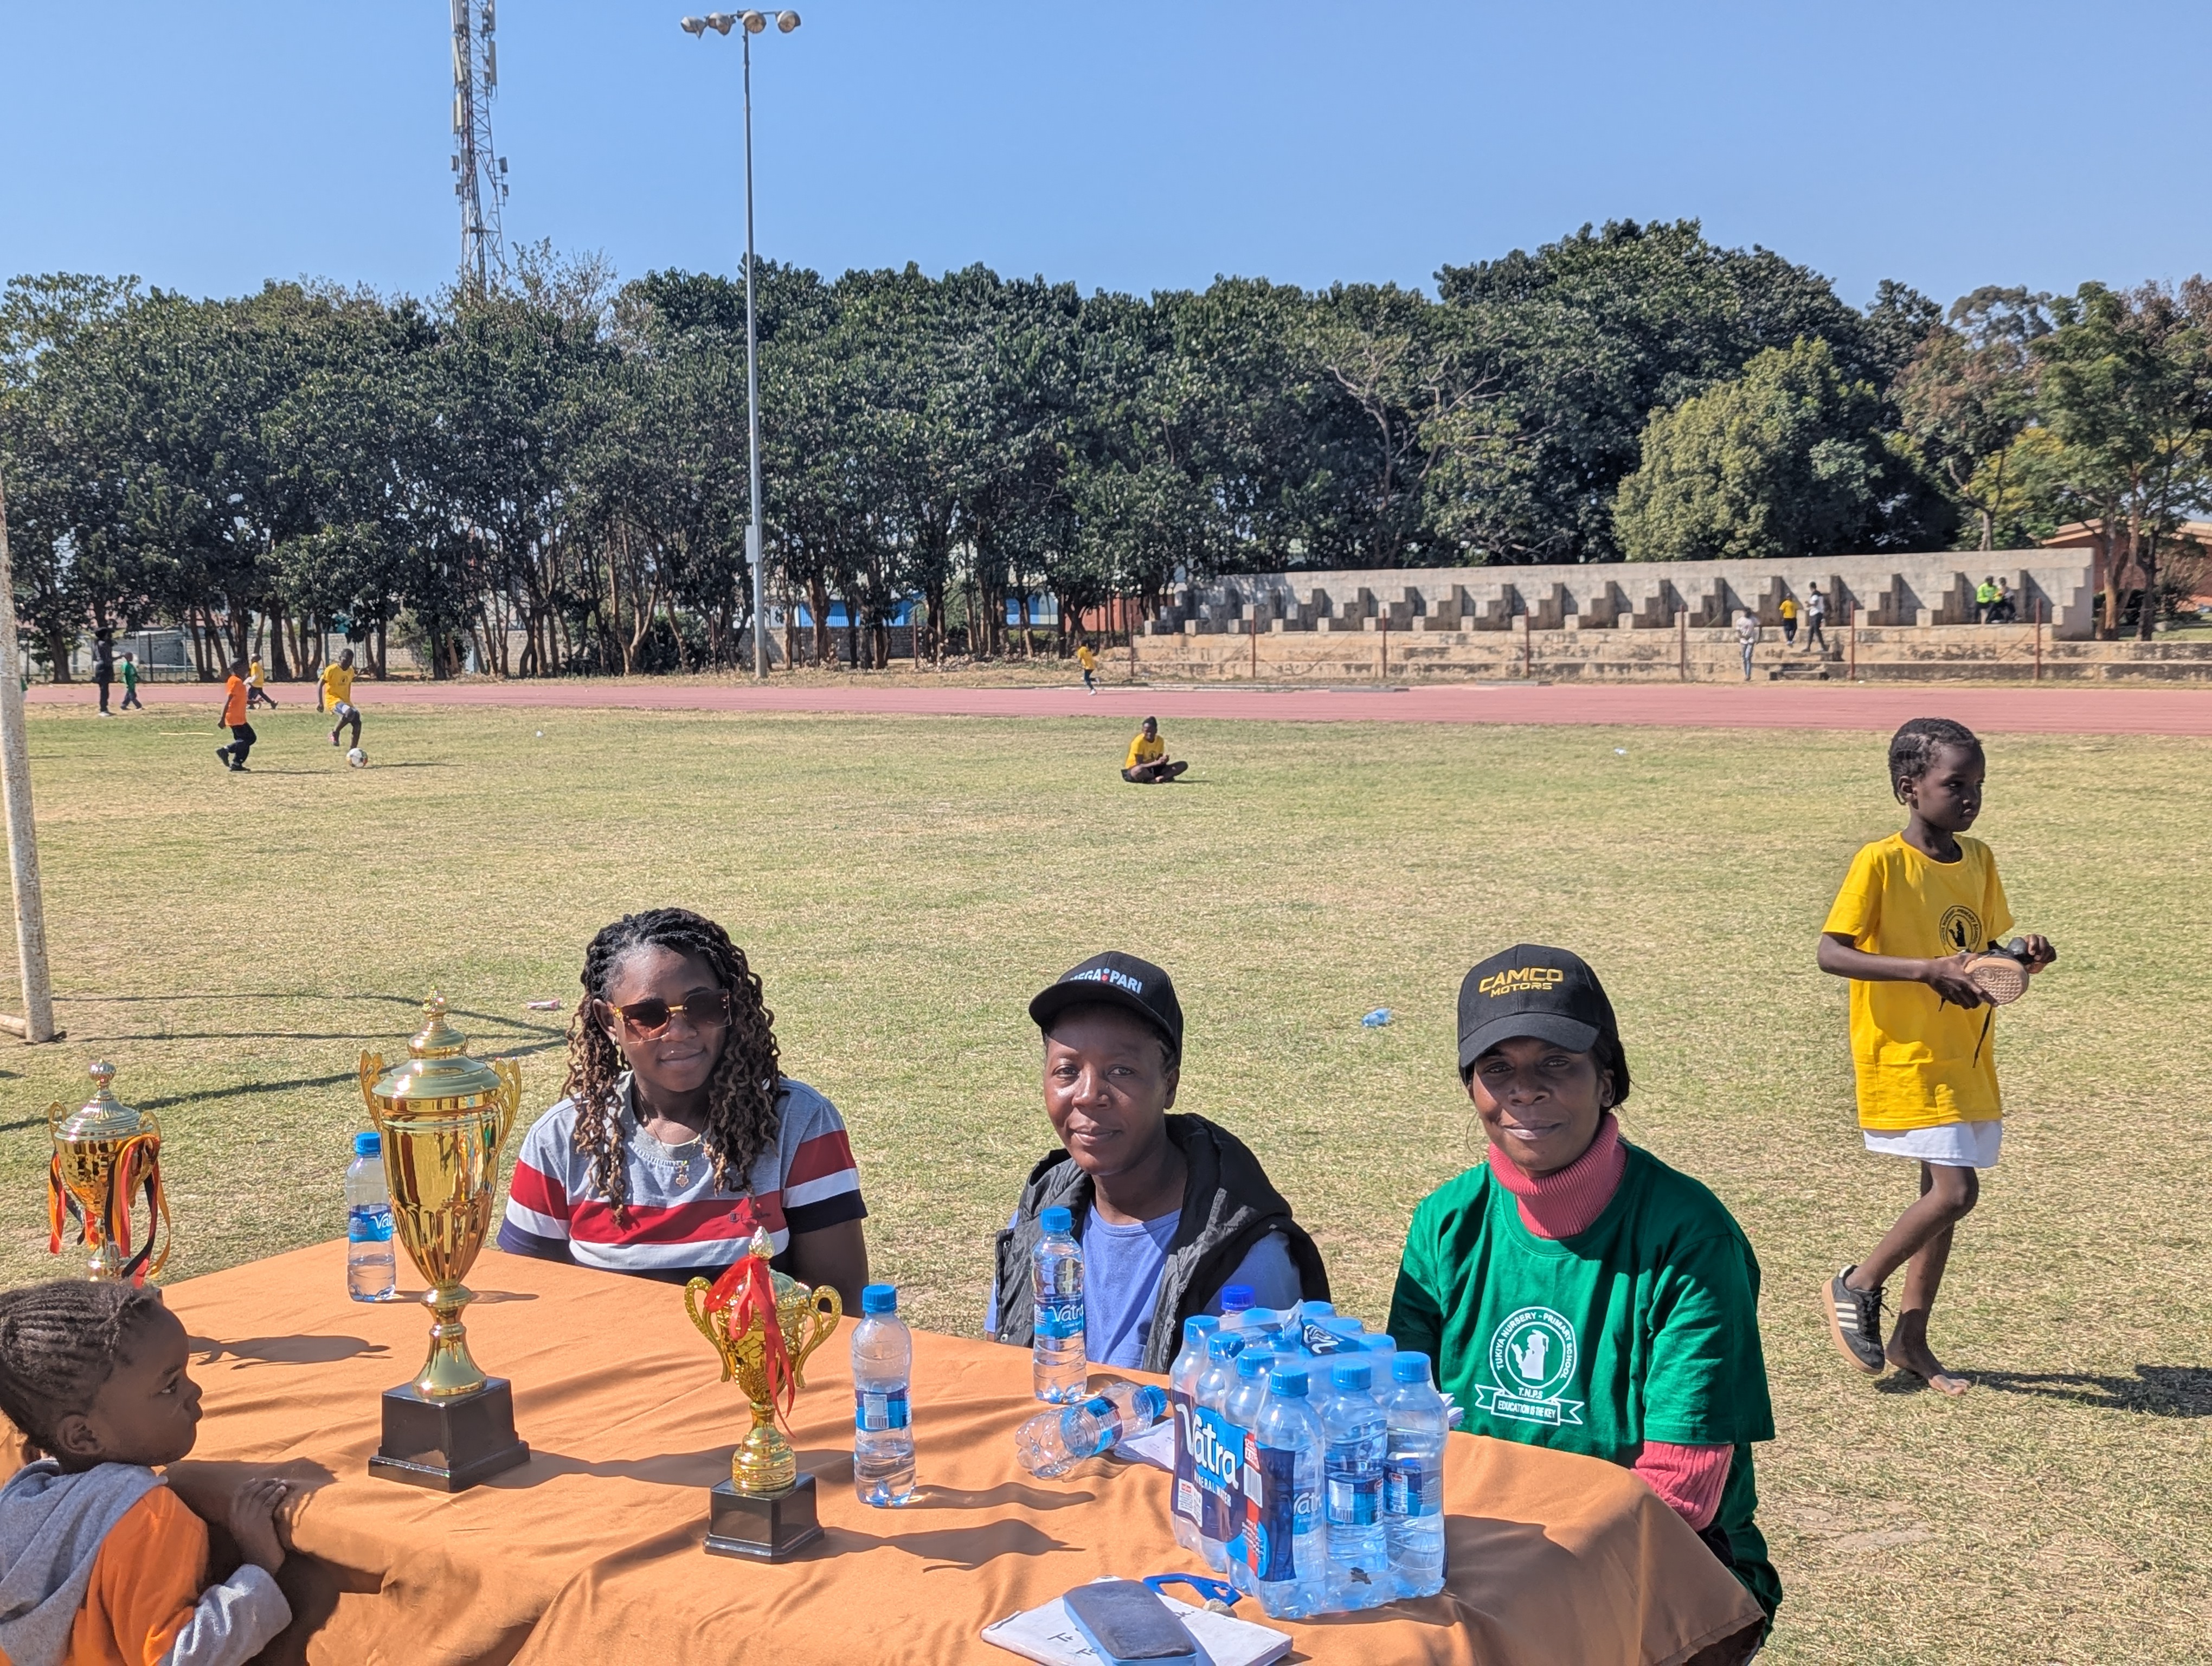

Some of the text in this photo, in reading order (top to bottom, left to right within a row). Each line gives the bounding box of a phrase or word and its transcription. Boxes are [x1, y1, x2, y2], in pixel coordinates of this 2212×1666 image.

[1109, 970, 1142, 994] PARI
[1478, 967, 1563, 993] CAMCO
[1490, 983, 1552, 997] MOTORS
[1495, 1338, 1506, 1370] TUKIYA
[1501, 1312, 1537, 1338] NURSERY
[1543, 1312, 1572, 1341] PRIMARY
[1560, 1342, 1573, 1379] SCHOOL
[1497, 1400, 1530, 1414] EDUCATION
[1529, 1405, 1535, 1415] IS
[1544, 1408, 1557, 1419] KEY
[1175, 1404, 1239, 1490] Vatra
